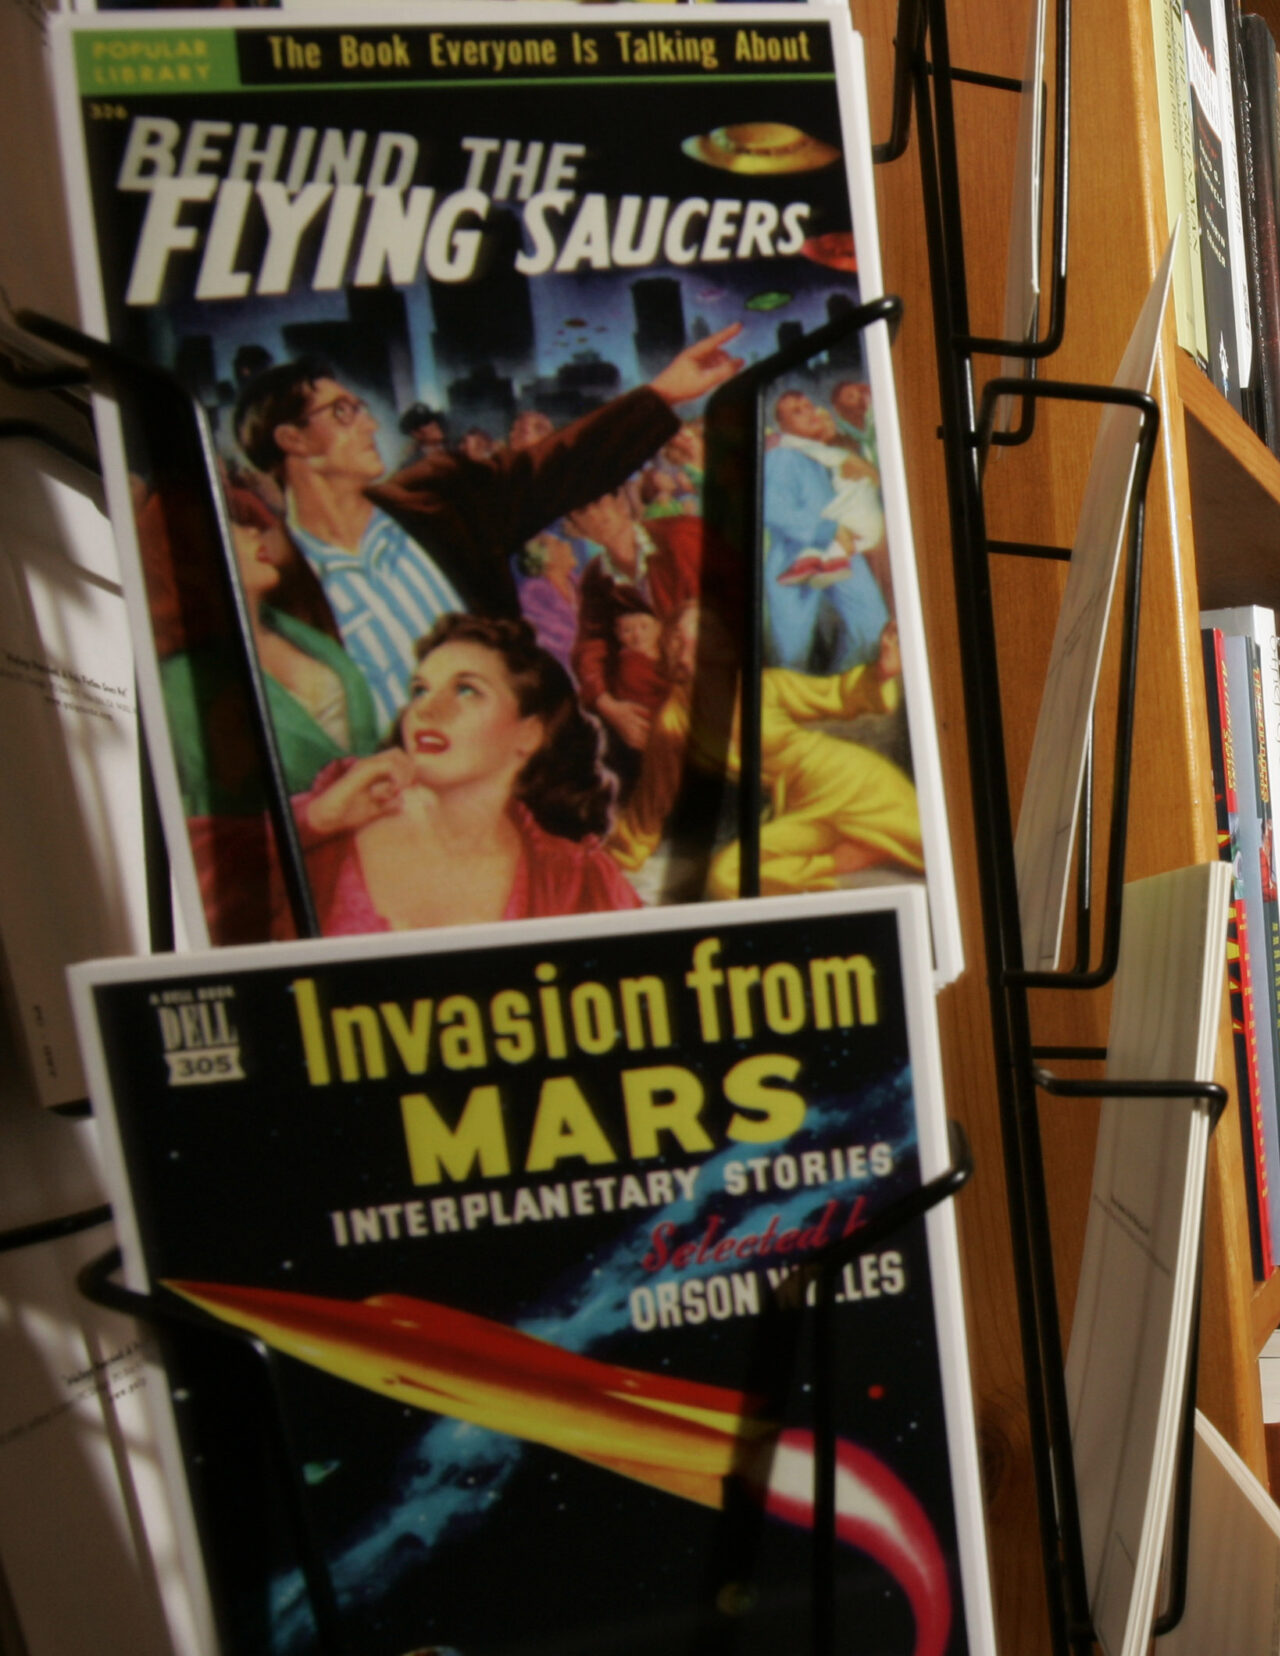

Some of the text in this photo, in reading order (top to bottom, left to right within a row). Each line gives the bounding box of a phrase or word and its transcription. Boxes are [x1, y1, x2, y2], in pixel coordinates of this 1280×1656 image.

[92, 40, 208, 60] POPULAR
[94, 64, 212, 83] LIBRARY
[269, 31, 811, 72] The Book Everyone Is Talking About
[118, 116, 585, 201] BEHIND THE
[125, 176, 812, 306] FLYING SAUCERS
[158, 1001, 240, 1052] DELL
[295, 938, 879, 1086] Invasion from
[177, 1055, 232, 1078] 305
[400, 1053, 807, 1187] MARS
[332, 1142, 894, 1247] INTERPLANETARY STORIES
[641, 1199, 838, 1272] Selected
[629, 1250, 907, 1332] ORSON LES
